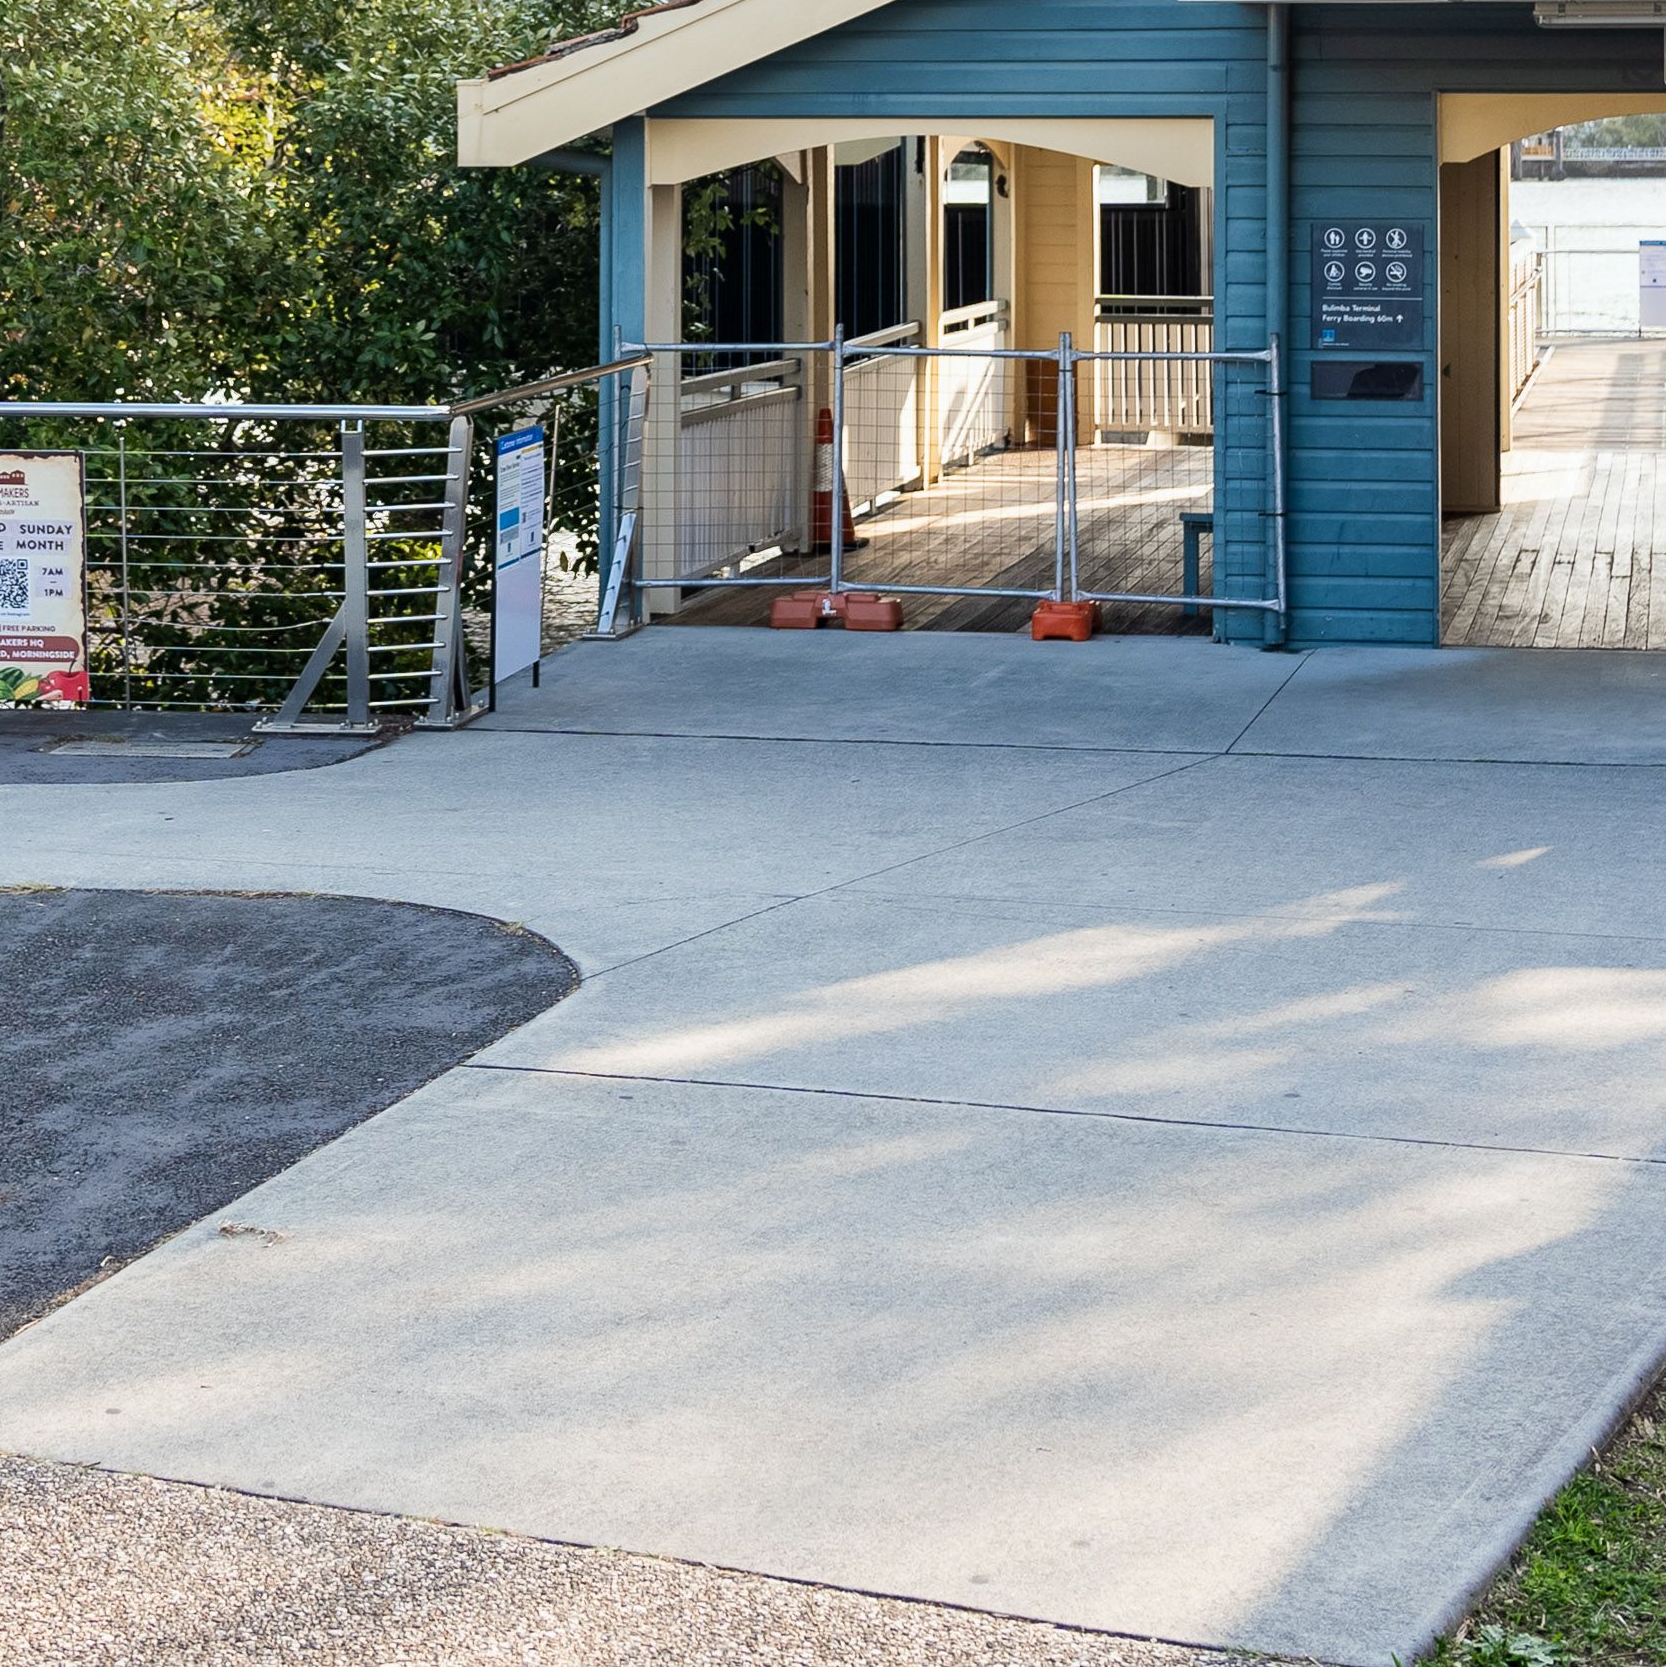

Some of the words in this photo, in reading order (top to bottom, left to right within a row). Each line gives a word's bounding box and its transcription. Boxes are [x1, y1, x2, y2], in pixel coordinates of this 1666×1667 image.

[1322, 304, 1350, 312] Bulimba
[1352, 304, 1381, 312] Terminal
[1322, 314, 1342, 323] Ferry
[1343, 314, 1375, 324] Boarding
[19, 524, 73, 534] SUNDAY
[16, 540, 64, 551] MONTH
[42, 568, 63, 576] 7AM
[29, 639, 45, 647] HQ
